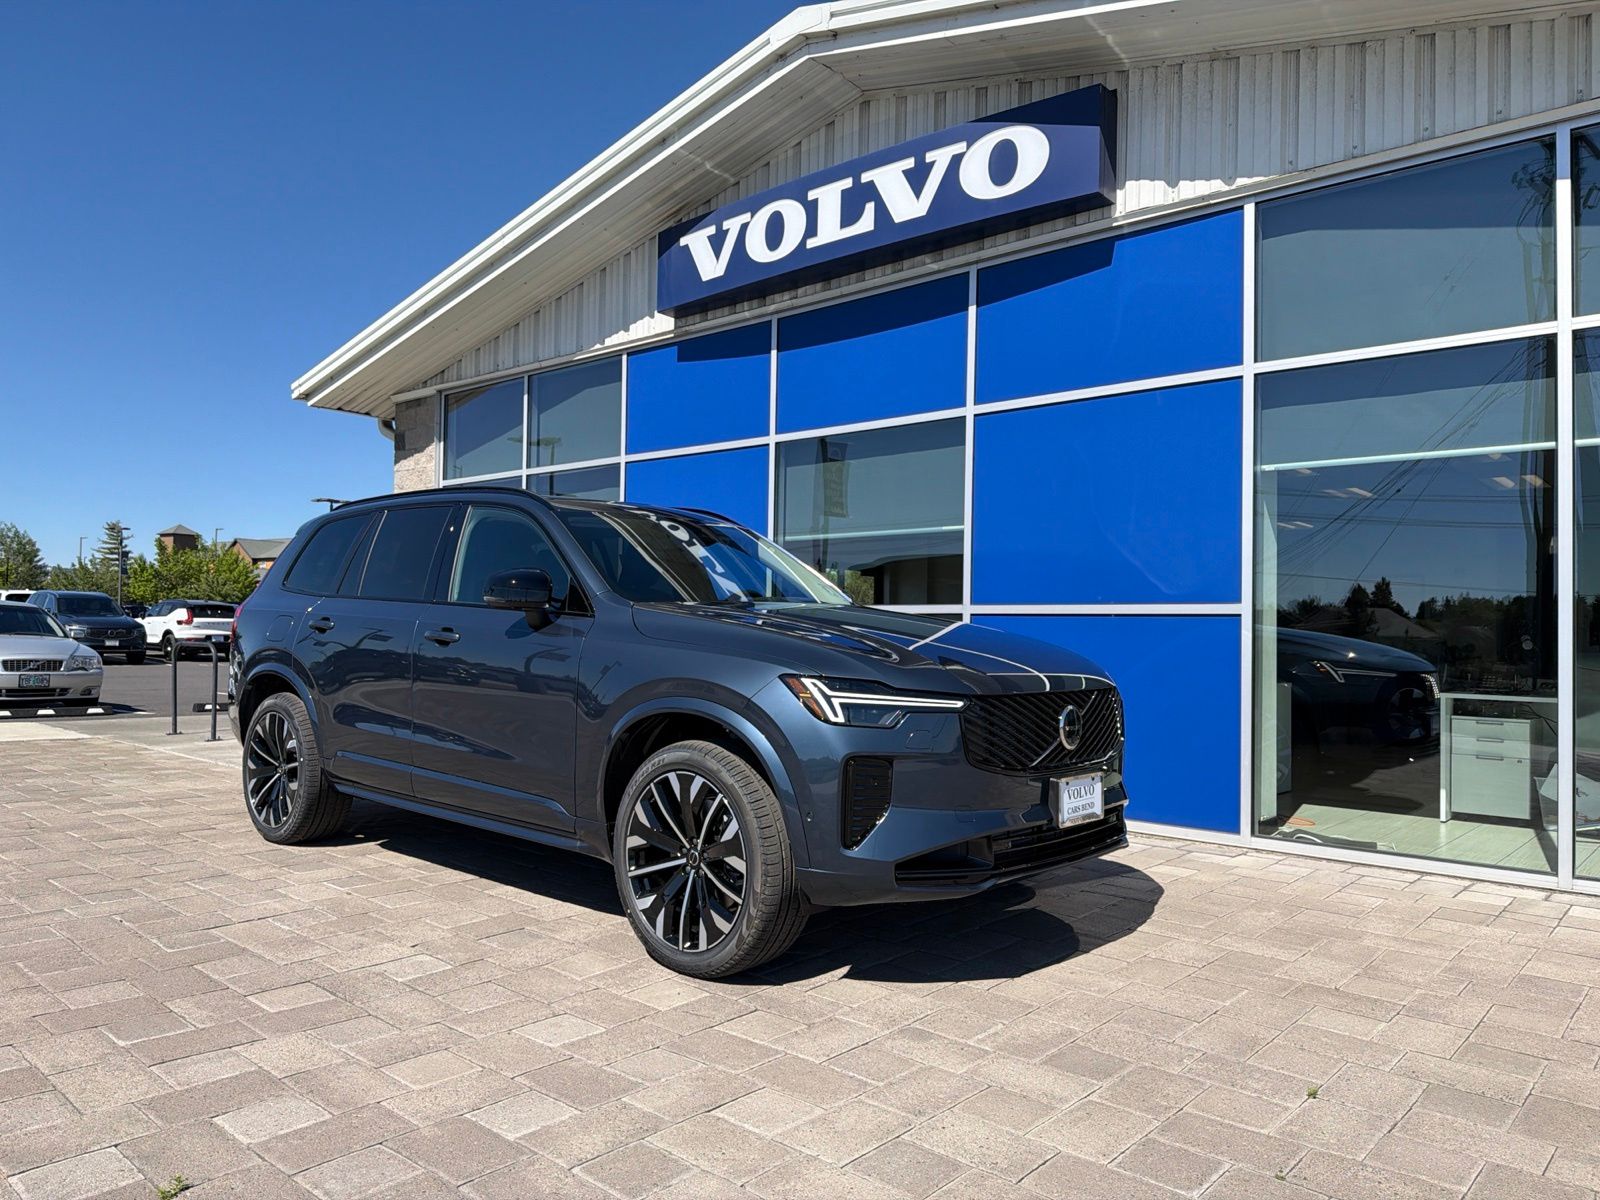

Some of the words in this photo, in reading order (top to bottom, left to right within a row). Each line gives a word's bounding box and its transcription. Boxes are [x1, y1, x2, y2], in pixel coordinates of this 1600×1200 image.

[680, 125, 1050, 281] VOLVO
[1067, 784, 1095, 800] VOLVO
[1067, 804, 1081, 815] CARS
[1081, 801, 1095, 812] BEND
